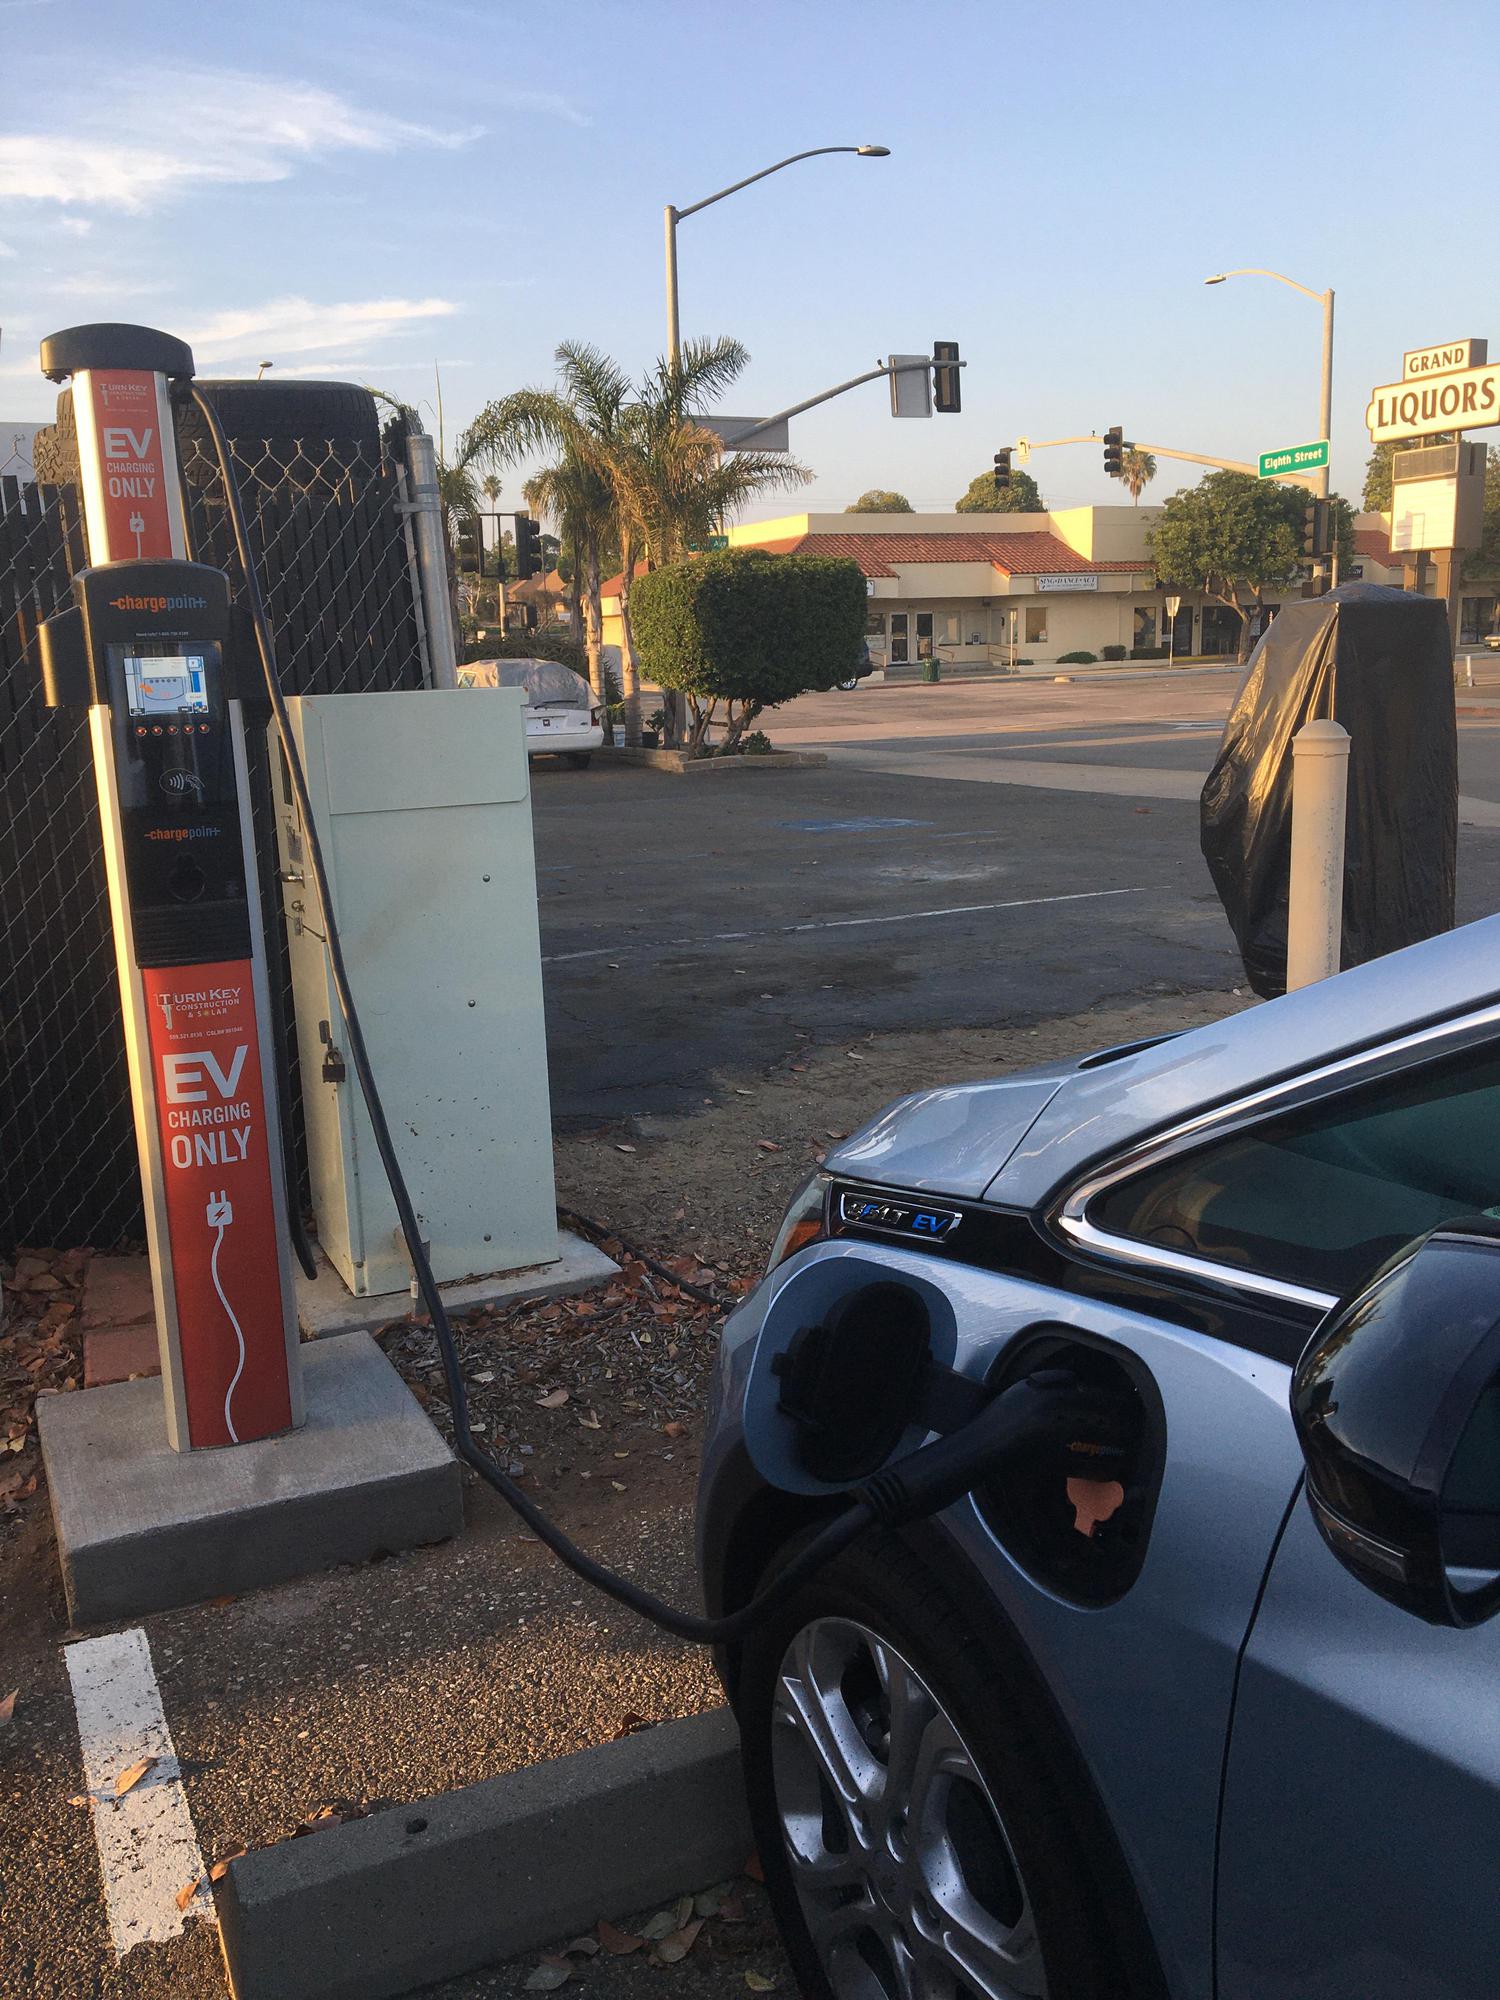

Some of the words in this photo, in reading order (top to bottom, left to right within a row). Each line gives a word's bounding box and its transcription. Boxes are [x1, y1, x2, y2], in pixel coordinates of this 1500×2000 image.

[1409, 347, 1464, 373] GRAND
[1377, 377, 1495, 428] LIQUORS
[103, 428, 153, 459] EV
[107, 462, 155, 473] CHARGING
[1264, 454, 1292, 470] Eighth
[1294, 448, 1322, 463] Street
[109, 477, 155, 498] ONLY
[159, 991, 206, 1004] TURN
[208, 987, 241, 1000] KEY
[176, 998, 240, 1011] CONSTRUCTION
[162, 1045, 249, 1104] EV
[168, 1102, 251, 1129] CHARGING
[170, 1125, 252, 1169] ONLY
[911, 1213, 948, 1232] EV
